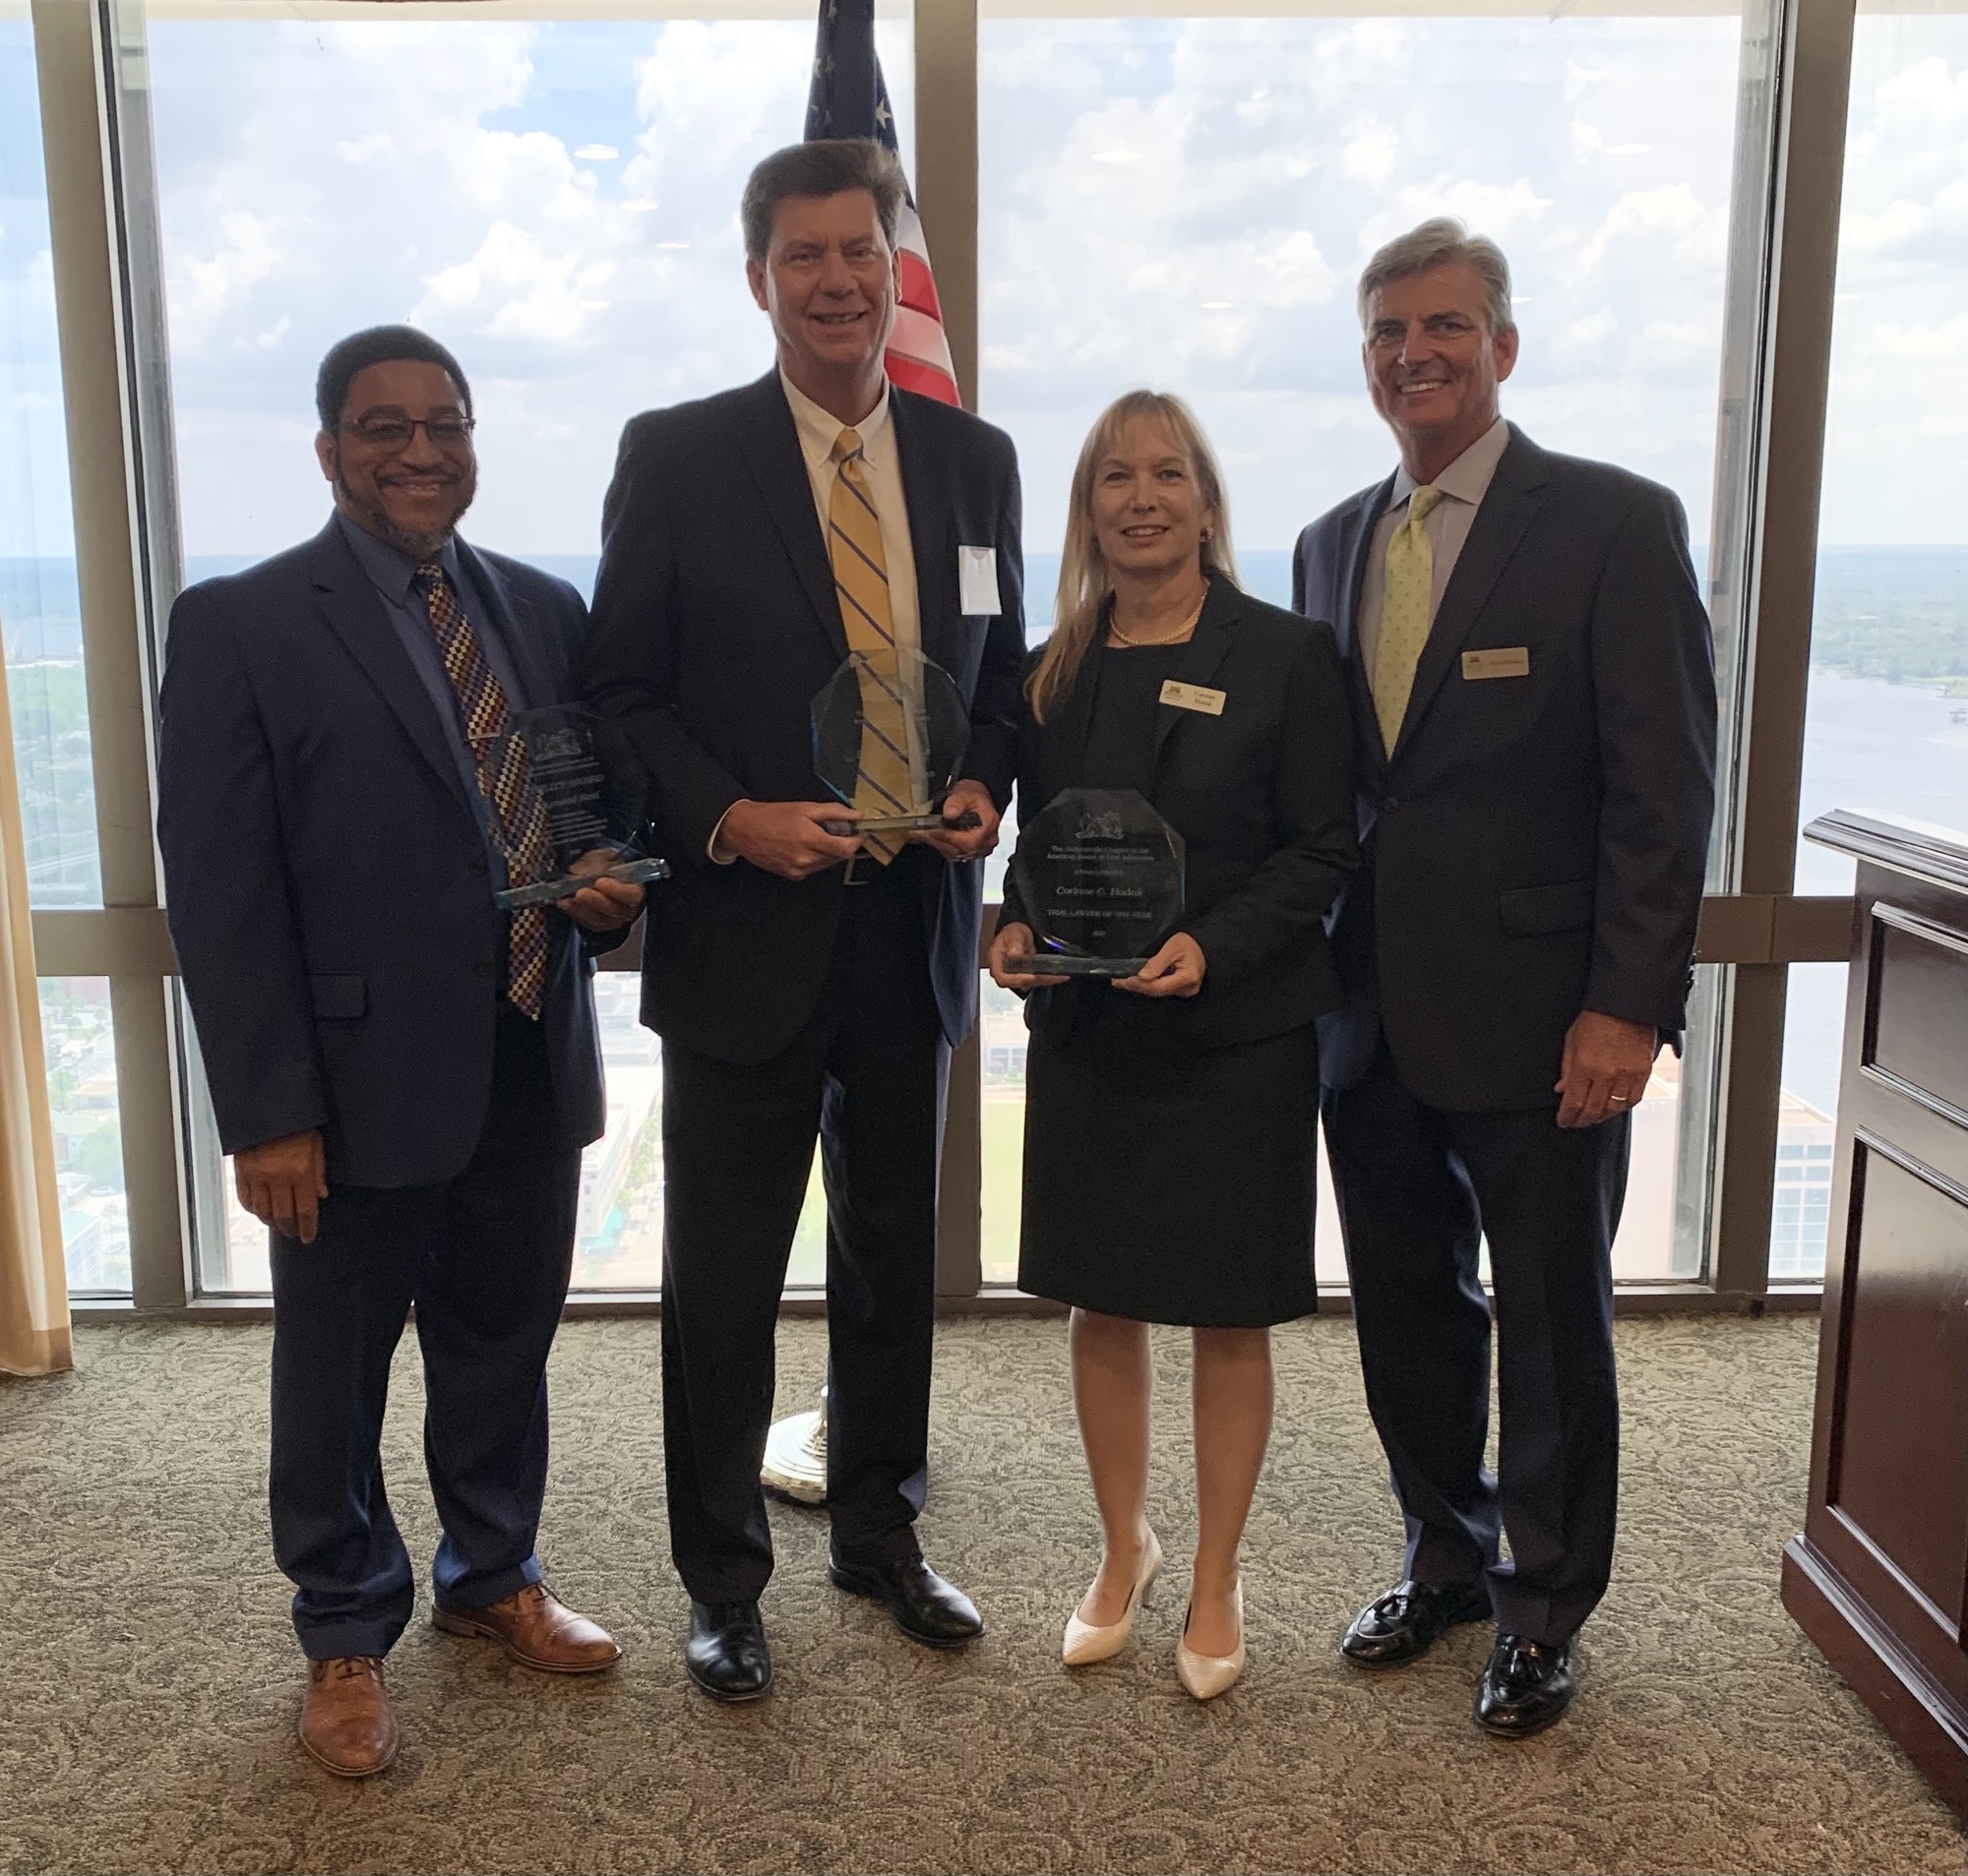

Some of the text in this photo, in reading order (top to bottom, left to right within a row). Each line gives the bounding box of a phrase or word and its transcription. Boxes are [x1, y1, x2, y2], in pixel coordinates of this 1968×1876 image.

[1056, 886, 1143, 896] Corinne C. Hodak
